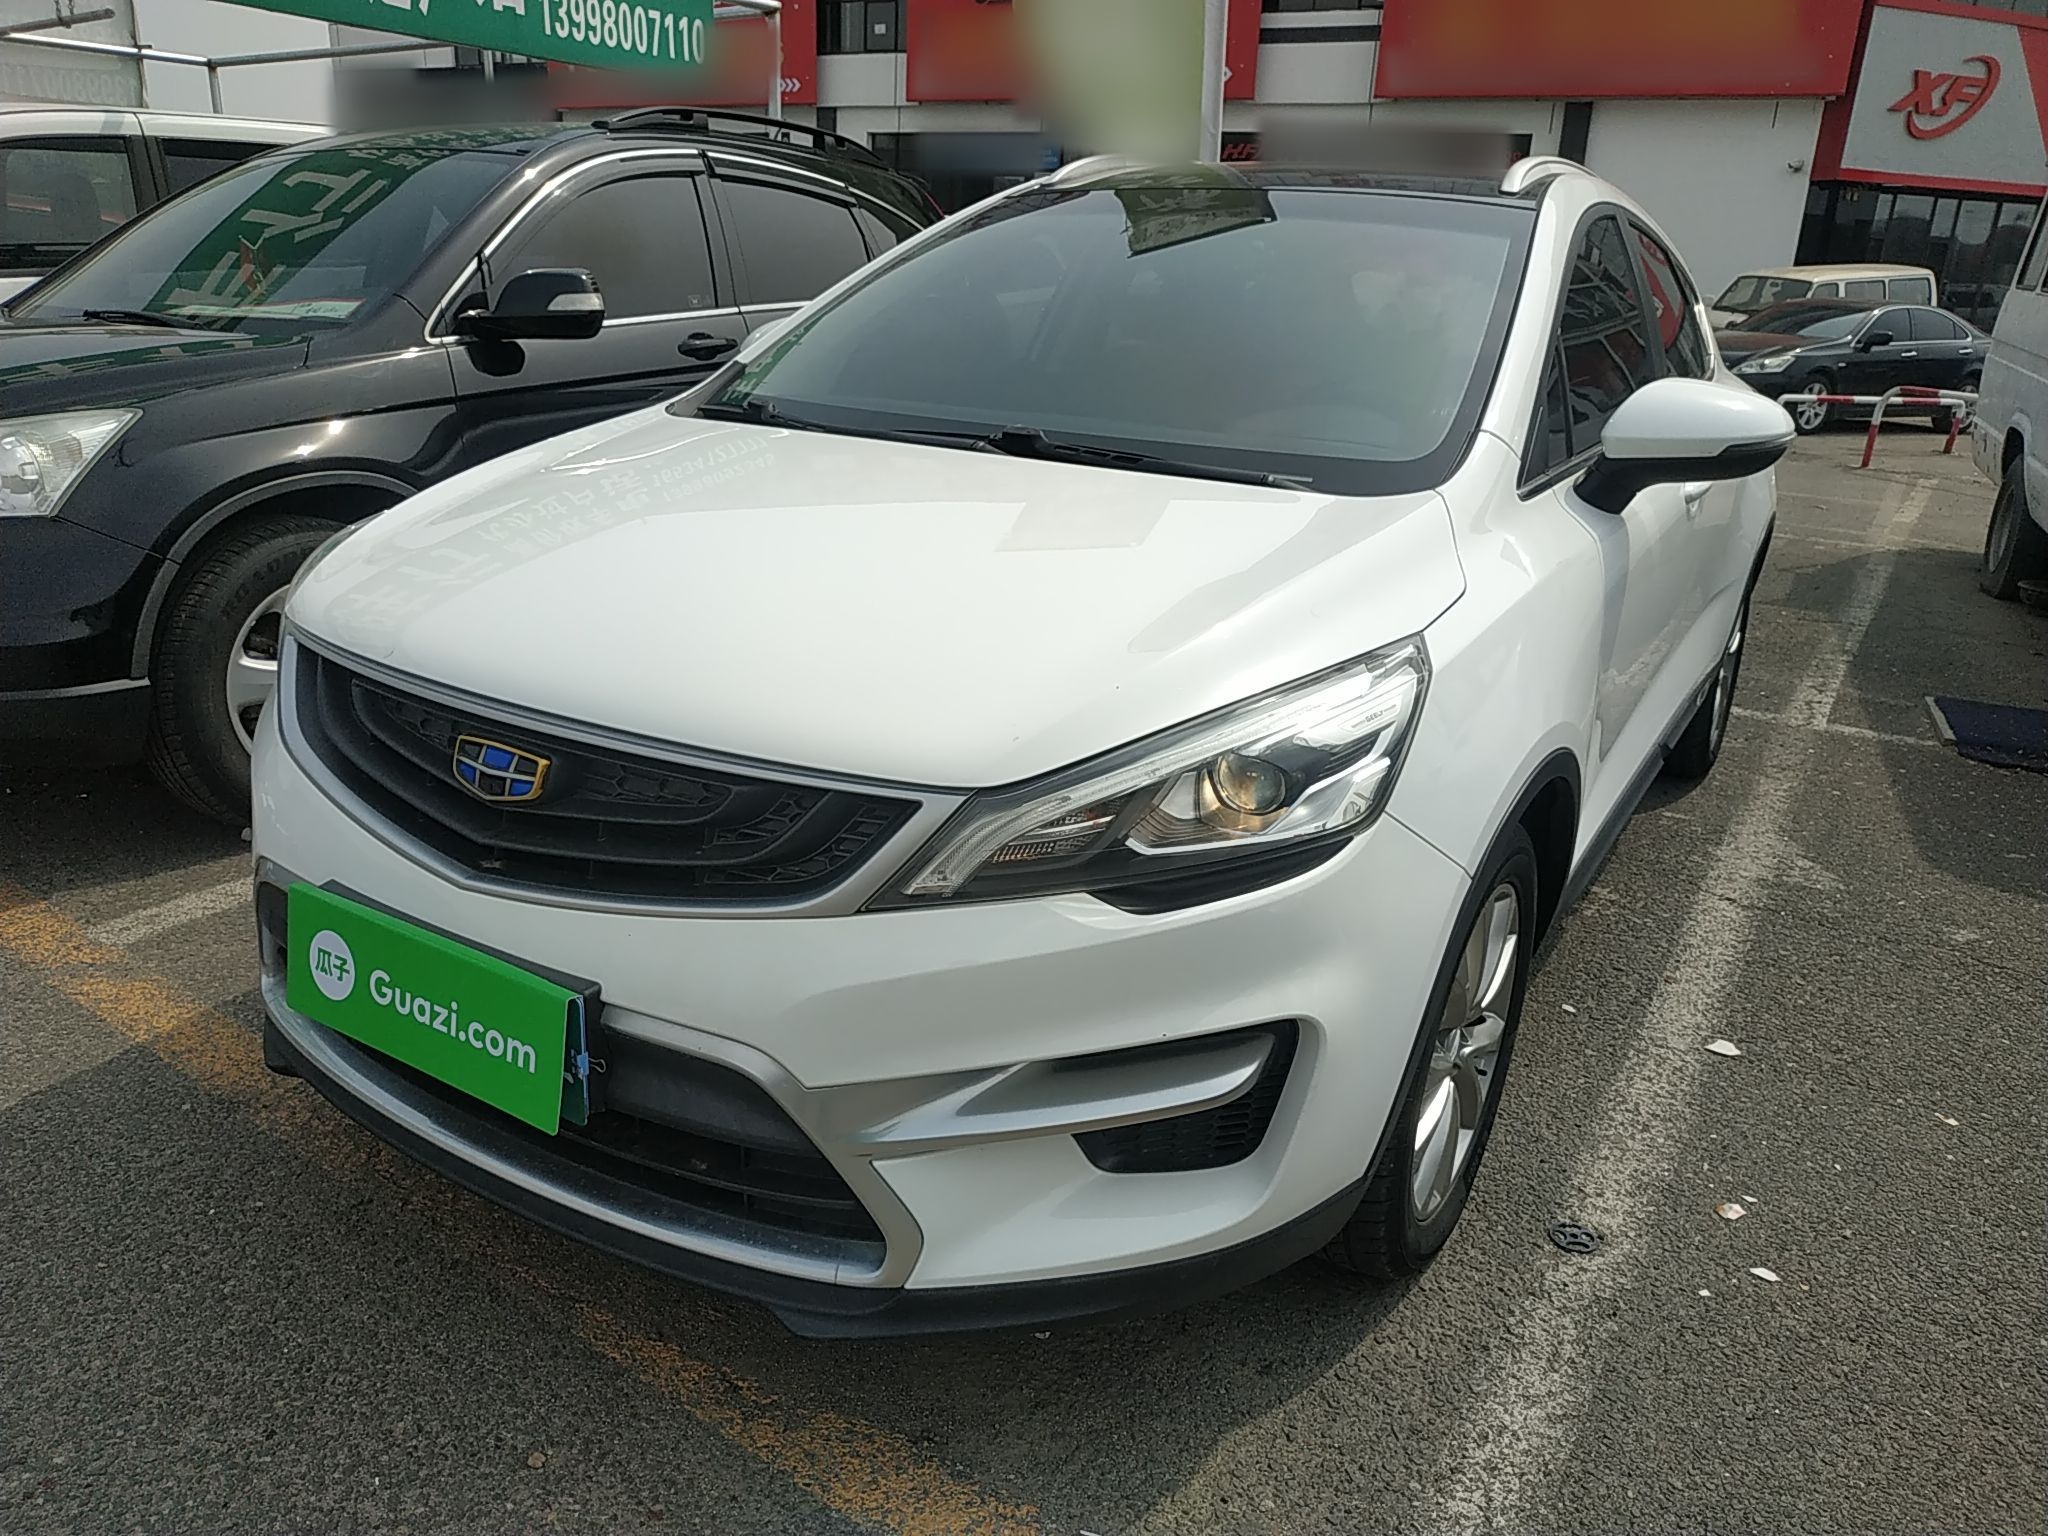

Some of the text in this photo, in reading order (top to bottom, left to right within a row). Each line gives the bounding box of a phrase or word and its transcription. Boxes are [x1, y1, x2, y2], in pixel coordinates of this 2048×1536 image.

[541, 0, 705, 64] 13998007110
[1887, 69, 1988, 117] XF
[315, 946, 350, 982] 瓜子
[369, 969, 536, 1074] Guazi.com
